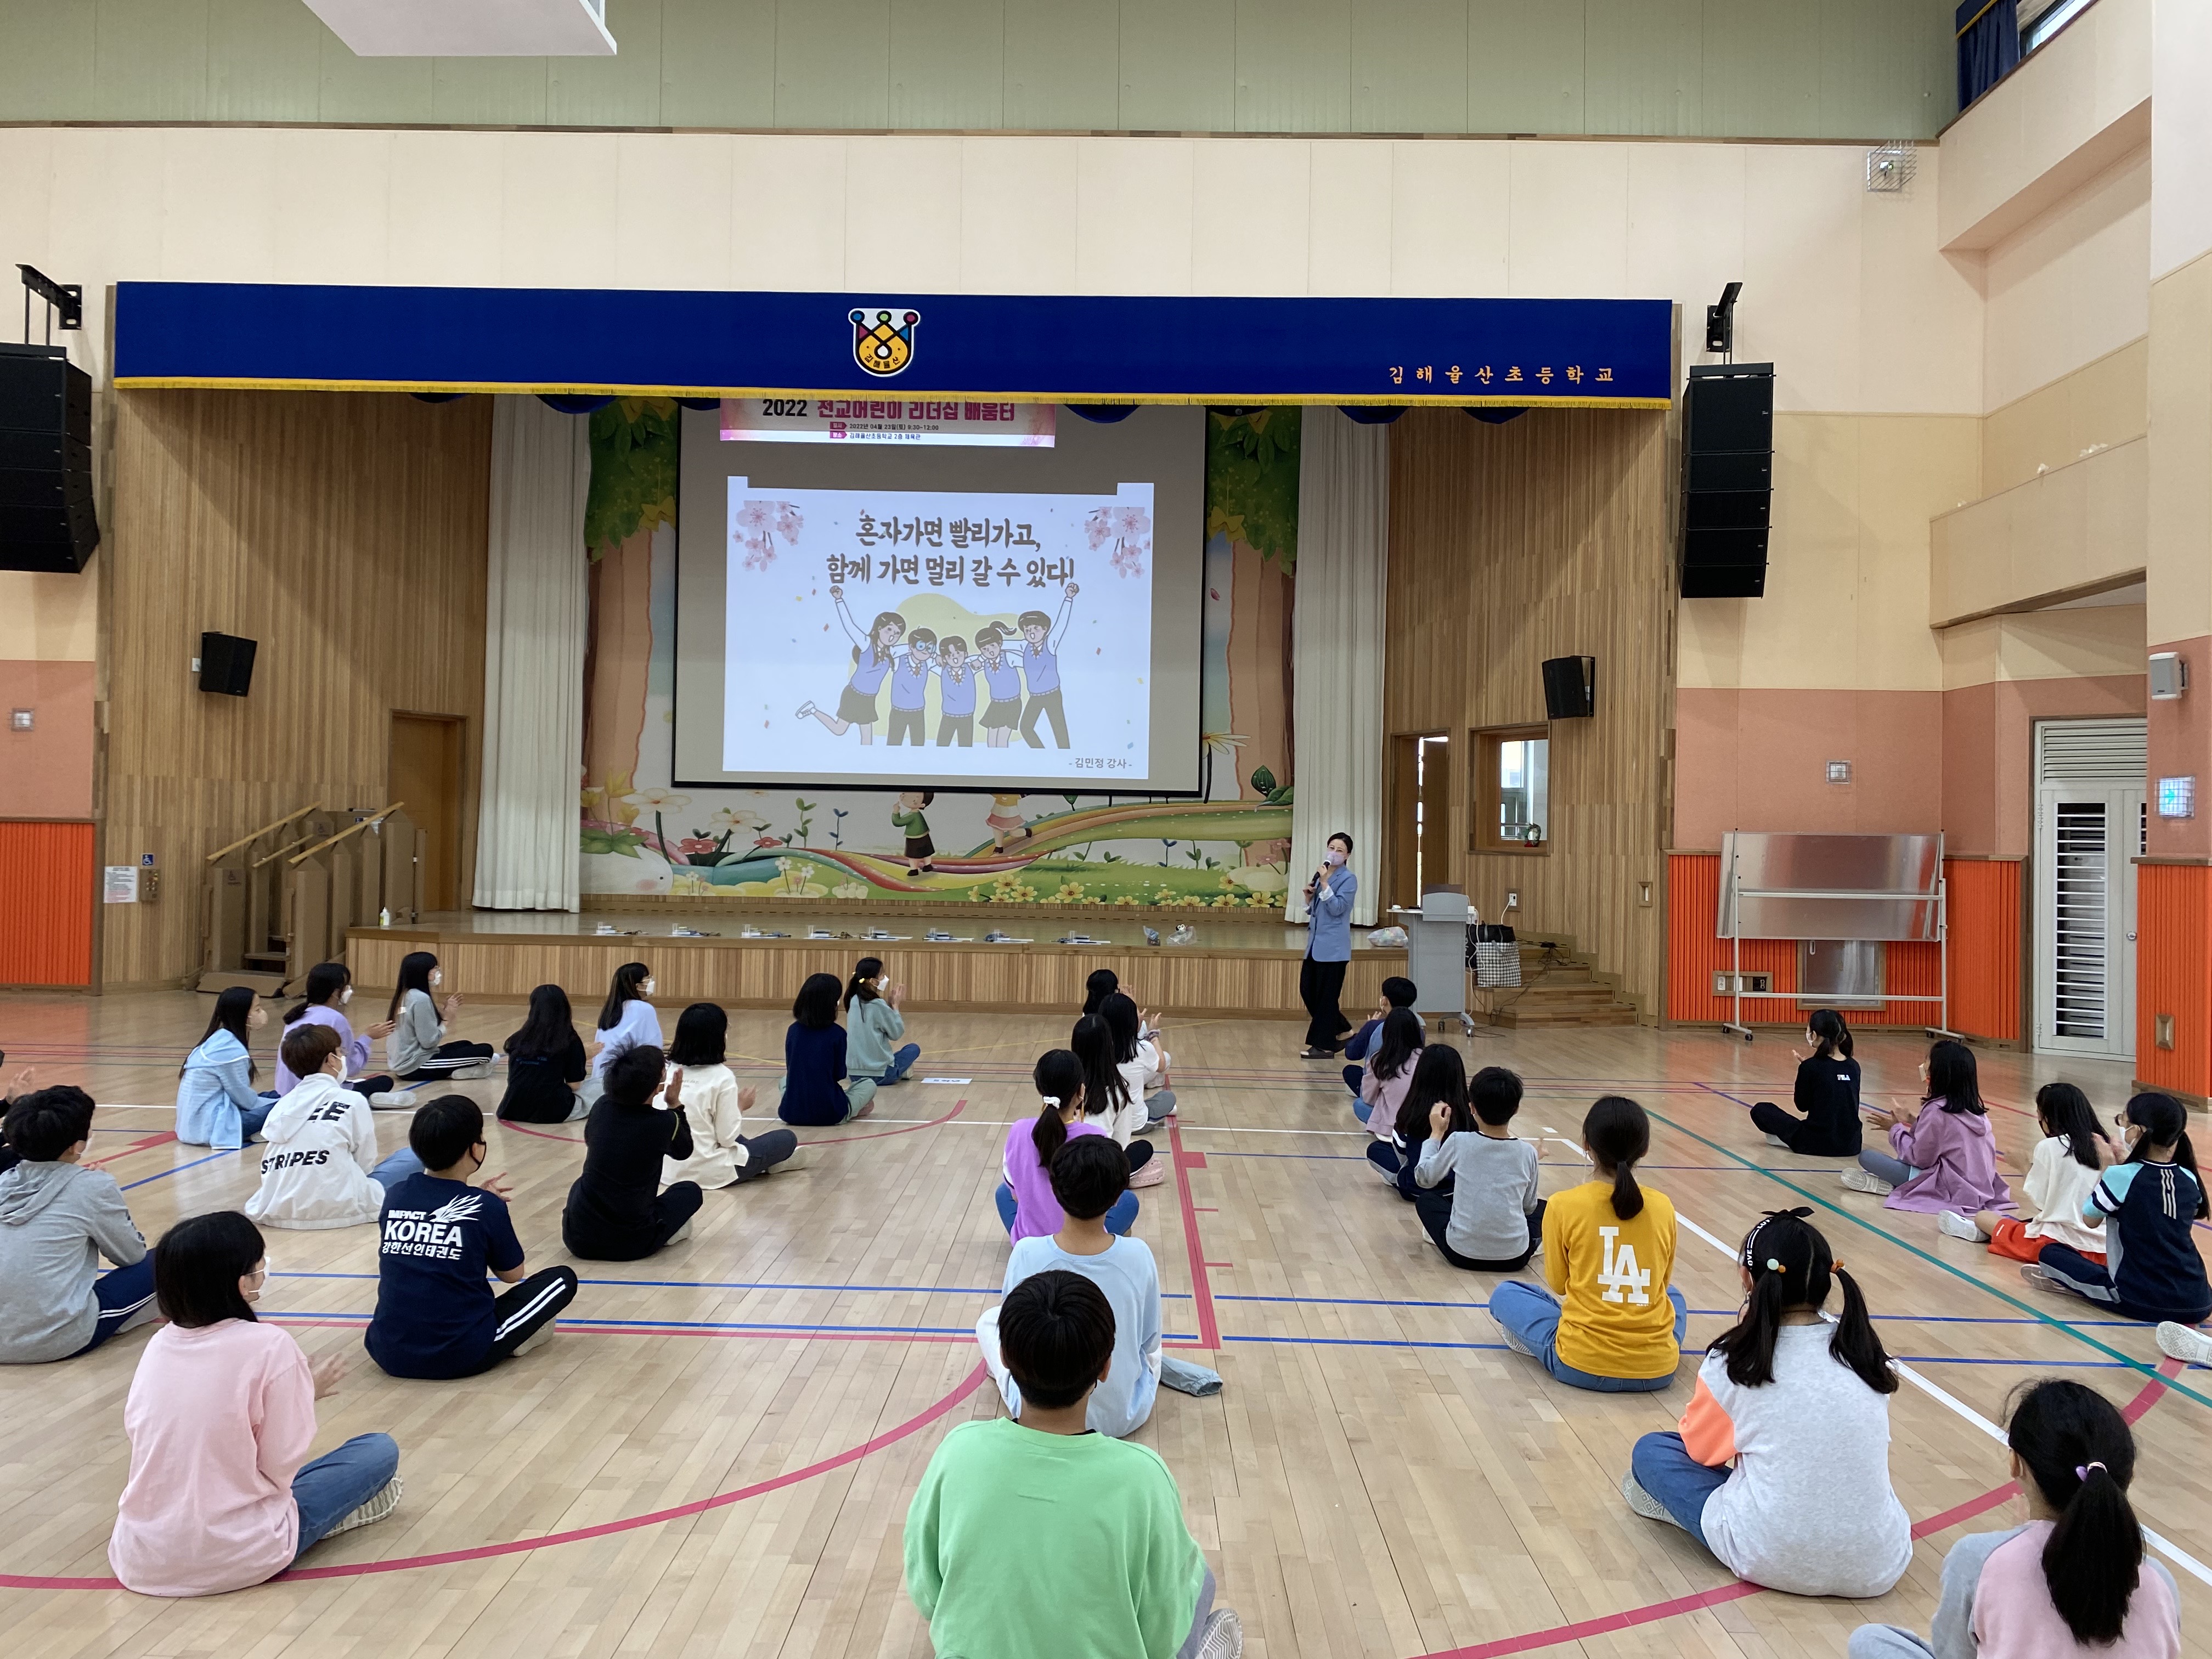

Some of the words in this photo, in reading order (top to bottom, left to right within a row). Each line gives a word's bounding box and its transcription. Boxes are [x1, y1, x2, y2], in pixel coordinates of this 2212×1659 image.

[1389, 365, 1613, 384] 김해율산초등학교
[763, 399, 808, 417] 2022
[817, 400, 902, 419] 전교어린이
[909, 402, 958, 420] 리더십
[964, 402, 1014, 421] 배움터
[856, 515, 943, 547] 혼자가면
[949, 518, 1041, 552] 빨리가고,
[826, 553, 871, 584] 함께
[877, 554, 918, 584] 가면
[926, 555, 964, 586] 멀리
[970, 557, 992, 587] 갈
[996, 558, 1021, 587] 수
[1026, 557, 1074, 588] 있다!
[1075, 758, 1104, 768] 김민정
[1107, 758, 1127, 769] 강사
[261, 1150, 330, 1175] STRIPES
[388, 1210, 427, 1221] IMPACT
[384, 1220, 462, 1248] KOREA
[382, 1242, 462, 1260] 강한선인태권도
[1597, 1226, 1651, 1304] LA
